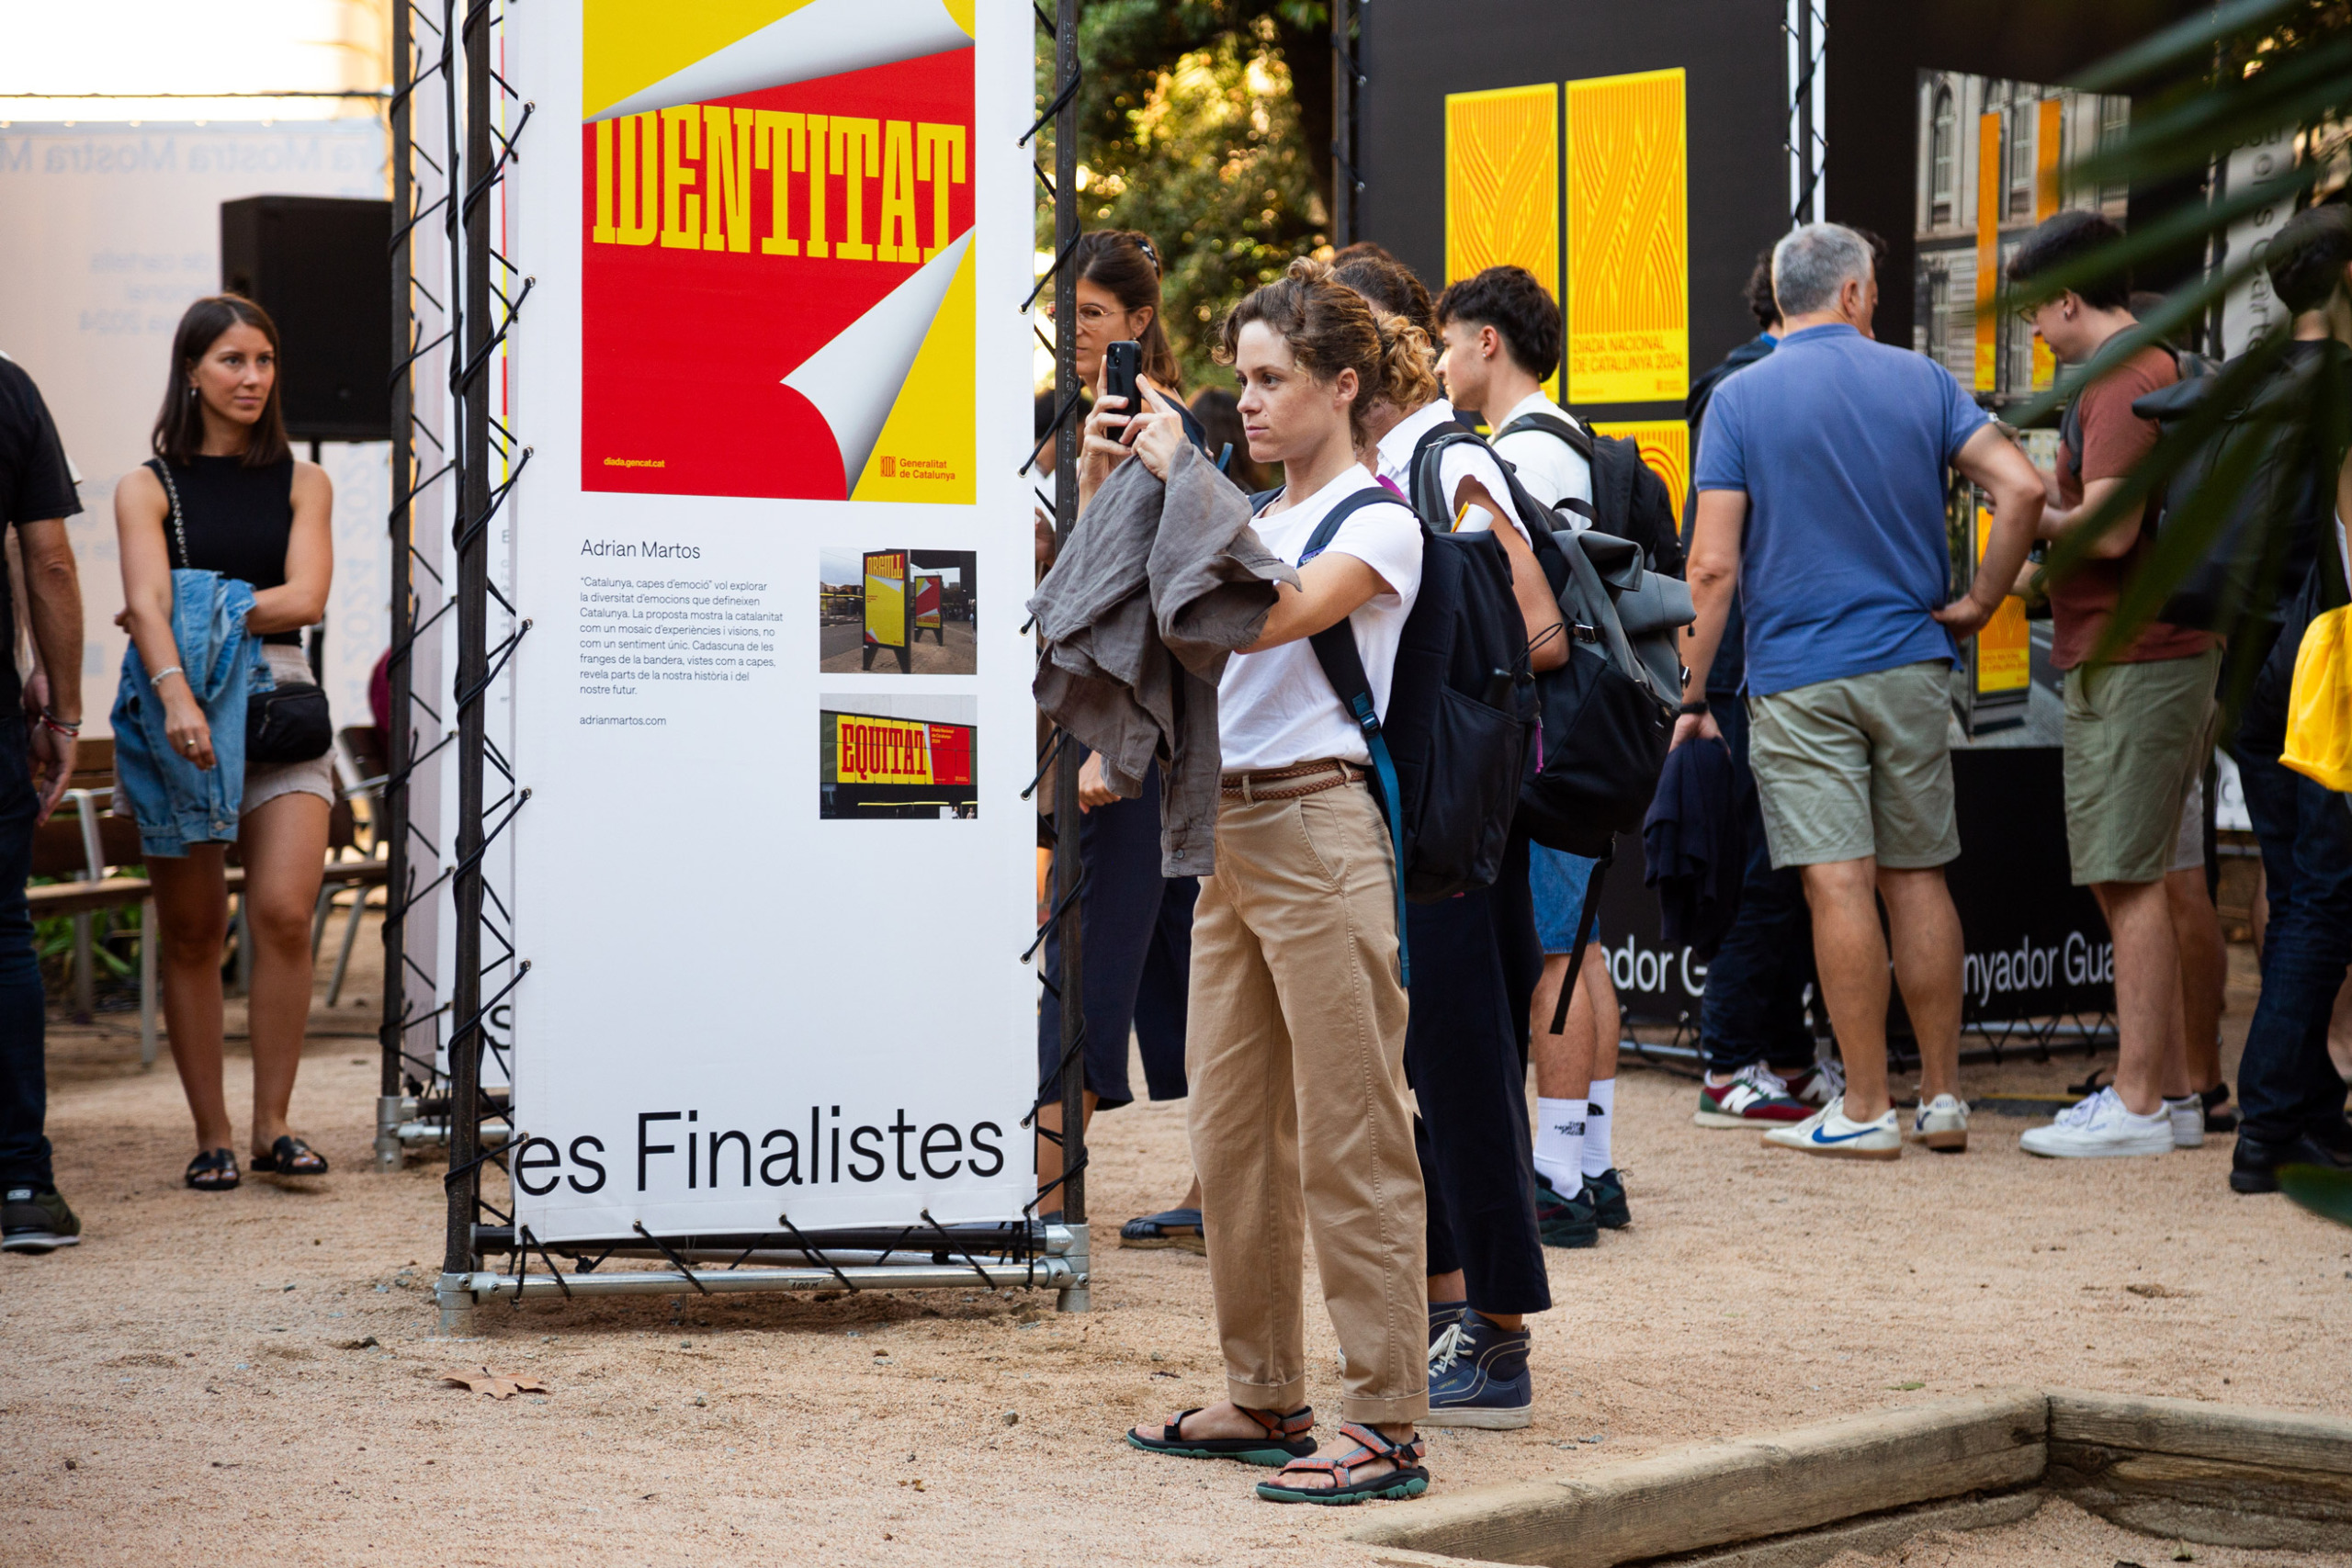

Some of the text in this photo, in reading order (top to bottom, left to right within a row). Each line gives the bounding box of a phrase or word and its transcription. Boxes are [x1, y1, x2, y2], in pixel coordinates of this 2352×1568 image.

[593, 104, 966, 264] IDENTITAT
[1573, 334, 1665, 353] DIADA NACIONAL
[1574, 352, 1683, 373] DE CATALUNYA 2024
[604, 457, 665, 468] diada.gencat.cat
[899, 458, 947, 468] Generalitat
[899, 469, 956, 481] de Catalunya
[581, 539, 701, 559] Adrian Martos
[636, 581, 665, 591] capes
[715, 581, 729, 591] vol
[729, 581, 768, 592] explorar
[581, 592, 589, 603] la
[591, 592, 635, 604] diversitat
[692, 597, 711, 607] que
[712, 595, 761, 606] defineixen
[580, 607, 784, 622] Catalunya. La proposta mostra la catalanitat
[580, 625, 603, 633] com
[604, 626, 616, 634] un
[618, 625, 653, 635] mosaic
[728, 626, 762, 637] visions,
[763, 629, 776, 637] no
[580, 639, 775, 652] com un sentiment únic. Cadascuna de les
[580, 654, 617, 667] franges
[618, 654, 632, 665] de
[633, 655, 642, 665] la
[643, 655, 685, 666] bandera,
[687, 656, 714, 666] vistes
[746, 659, 776, 669] capes,
[580, 670, 609, 680] revela
[611, 671, 637, 682] parts
[638, 671, 650, 681] de
[652, 671, 661, 681] la
[662, 671, 693, 681] nostra
[695, 671, 729, 682] història
[735, 672, 750, 682] del
[580, 685, 638, 695] nostre futur.
[580, 716, 667, 727] adrianmartos.com
[842, 723, 927, 781] EQUITAT
[1964, 935, 2059, 1008] nyador
[514, 1105, 1004, 1196] es Finalistes
